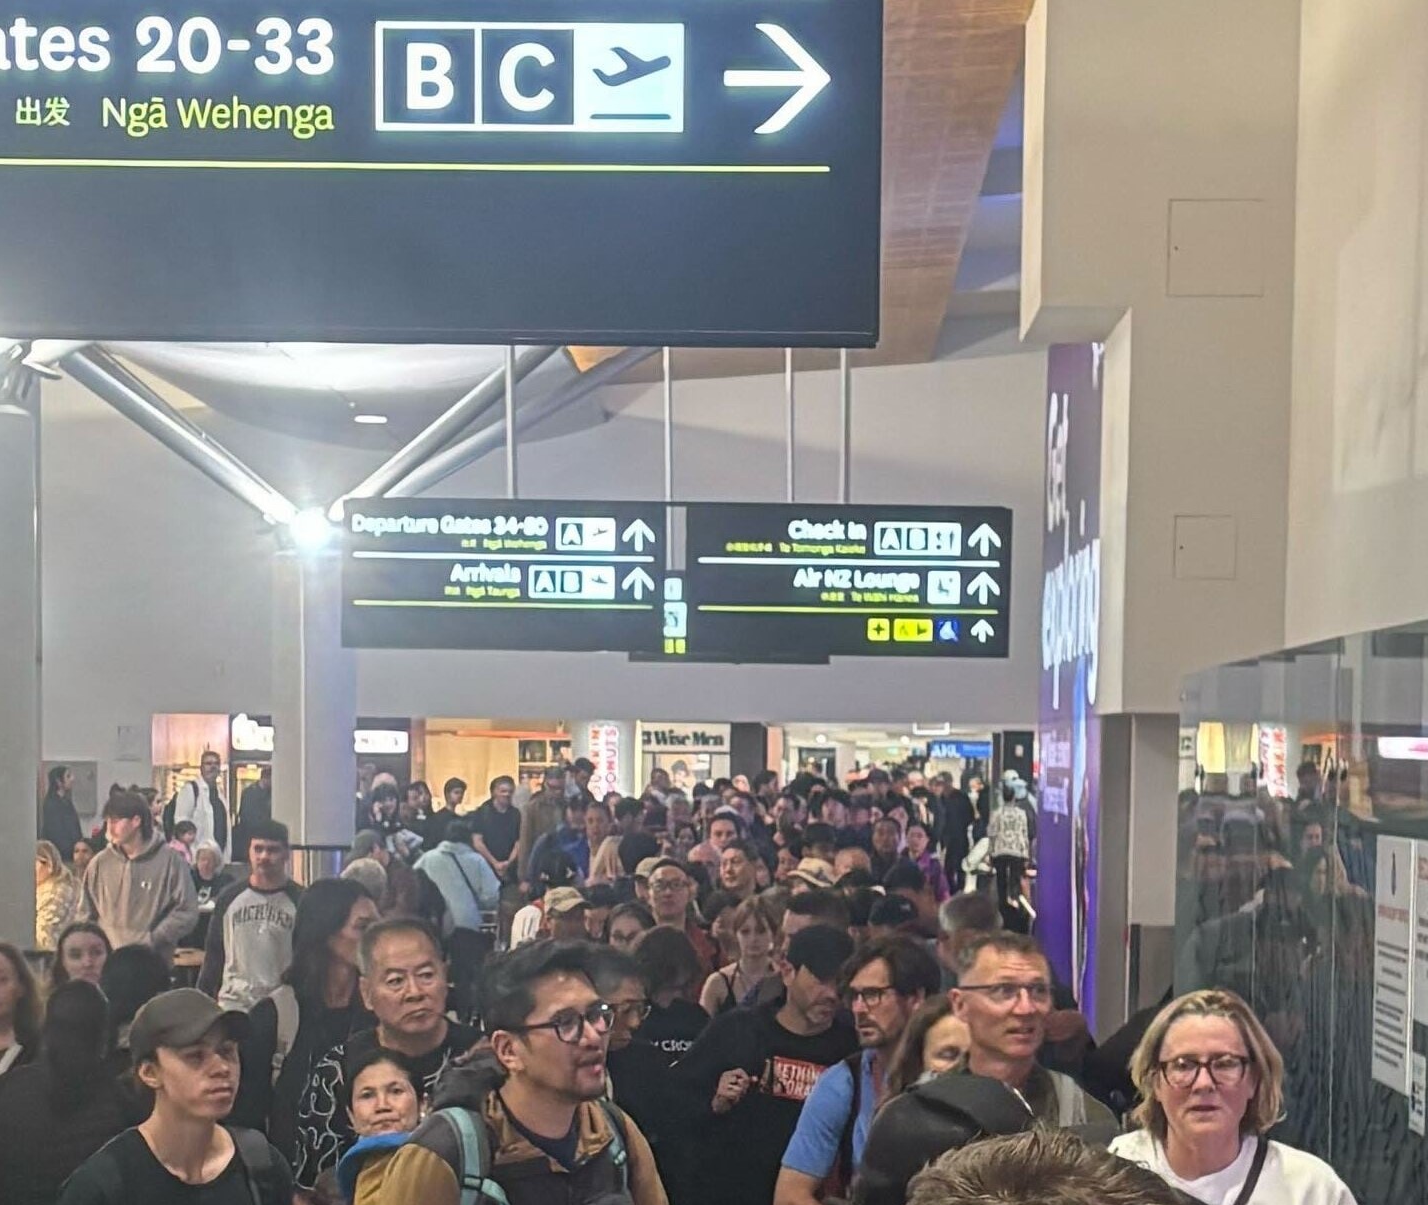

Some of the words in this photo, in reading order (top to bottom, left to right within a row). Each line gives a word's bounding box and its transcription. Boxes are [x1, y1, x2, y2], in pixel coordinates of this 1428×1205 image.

[135, 16, 335, 75] 20-33
[406, 42, 454, 110] B
[499, 42, 555, 112] C
[14, 96, 71, 127] 出发
[102, 96, 168, 138] Ngā
[177, 95, 335, 140] Wehenga
[351, 513, 439, 537] Departure
[787, 518, 845, 541] Check
[450, 562, 522, 584] Arrivals
[793, 567, 823, 588] Air
[824, 569, 852, 589] NZ
[853, 569, 920, 593] Lounge
[641, 730, 652, 745] 3
[654, 729, 691, 747] Wise
[692, 730, 726, 747] Men
